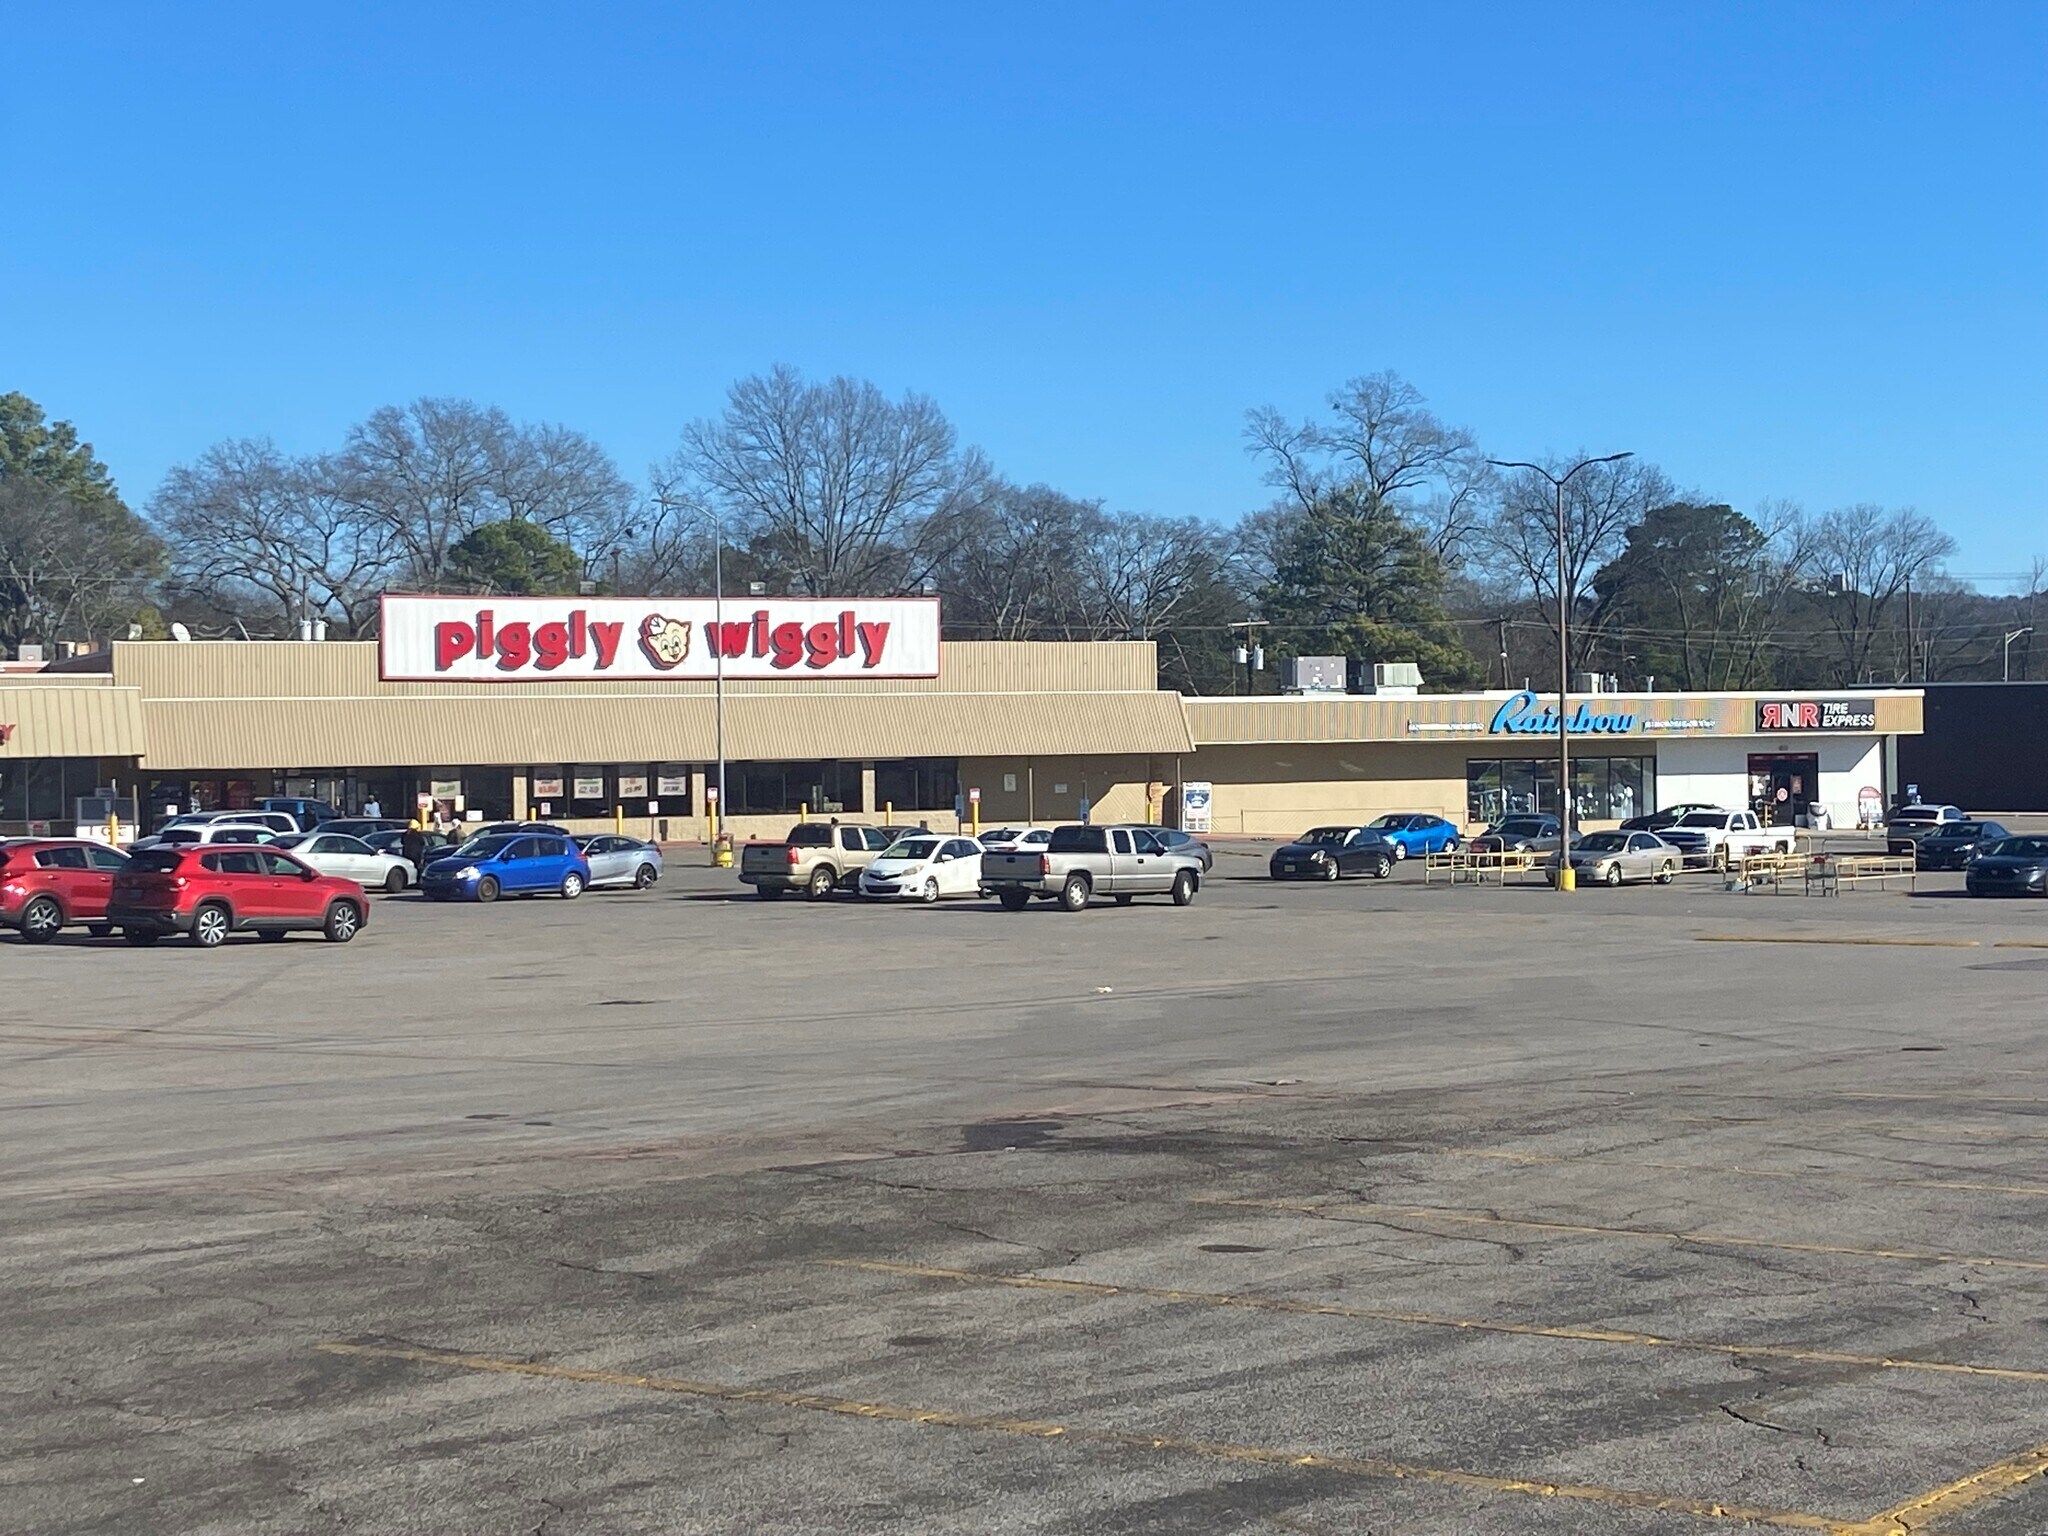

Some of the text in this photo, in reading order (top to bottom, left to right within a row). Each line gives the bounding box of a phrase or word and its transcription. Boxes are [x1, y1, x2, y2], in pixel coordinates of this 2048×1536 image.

[434, 609, 891, 672] piggly wiggly
[1488, 690, 1638, 735] Rainbow
[1822, 703, 1849, 715] TIRE
[1822, 714, 1875, 727] EXPRESS
